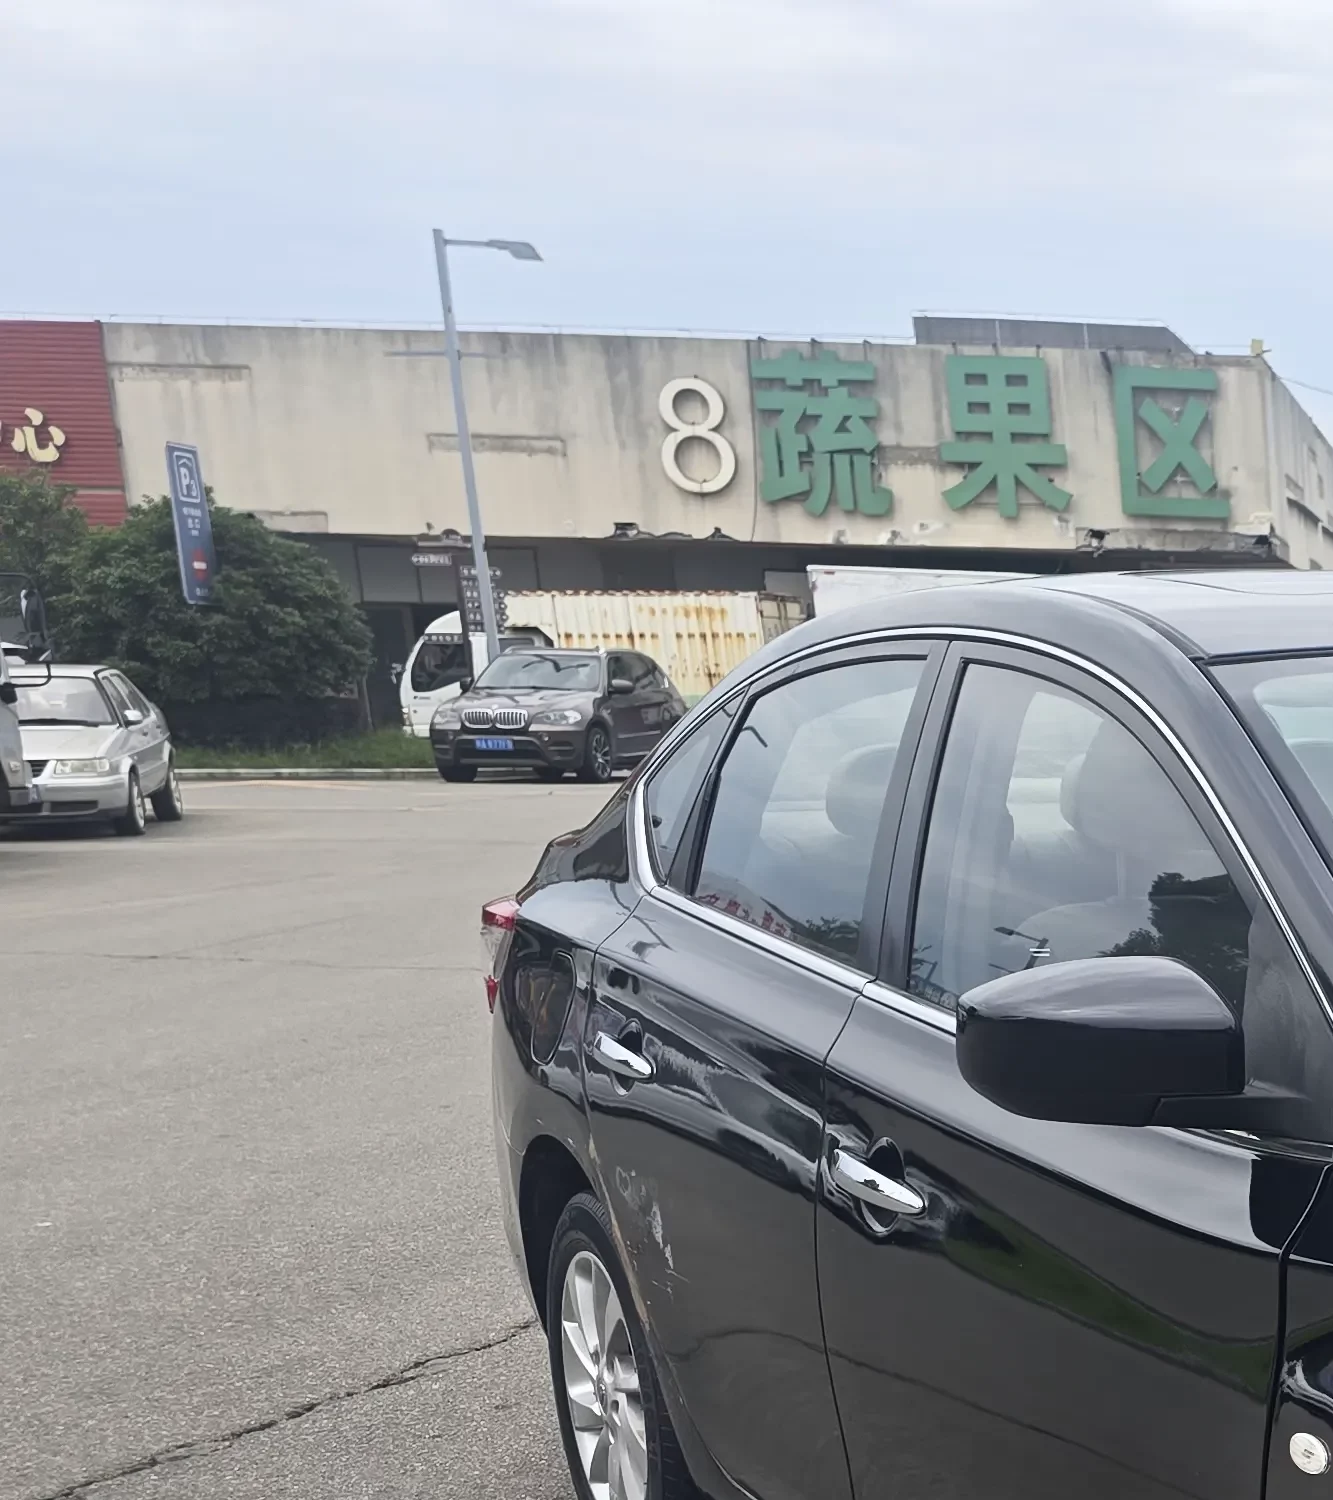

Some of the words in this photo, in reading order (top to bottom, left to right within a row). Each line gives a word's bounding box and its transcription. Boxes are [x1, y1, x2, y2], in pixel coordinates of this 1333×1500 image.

[0, 407, 66, 463] 心
[658, 376, 737, 494] 8
[750, 349, 1232, 519] 蔬果区
